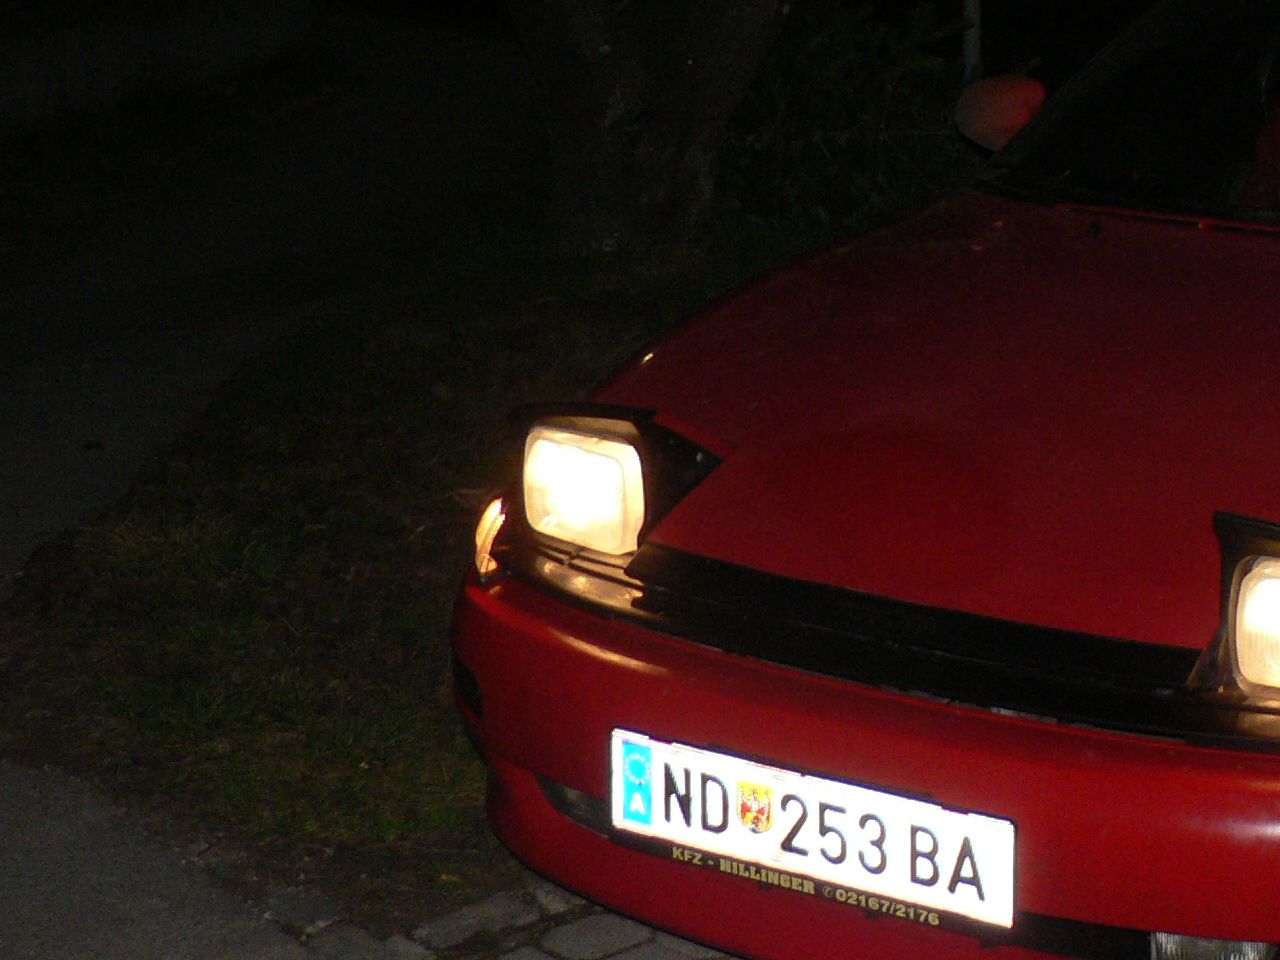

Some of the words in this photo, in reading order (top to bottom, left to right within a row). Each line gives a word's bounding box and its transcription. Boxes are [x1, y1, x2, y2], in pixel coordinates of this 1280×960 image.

[629, 791, 646, 815] A
[663, 761, 729, 834] ND
[779, 793, 888, 874] 253
[910, 824, 985, 902] BA
[672, 845, 704, 866] KFZ
